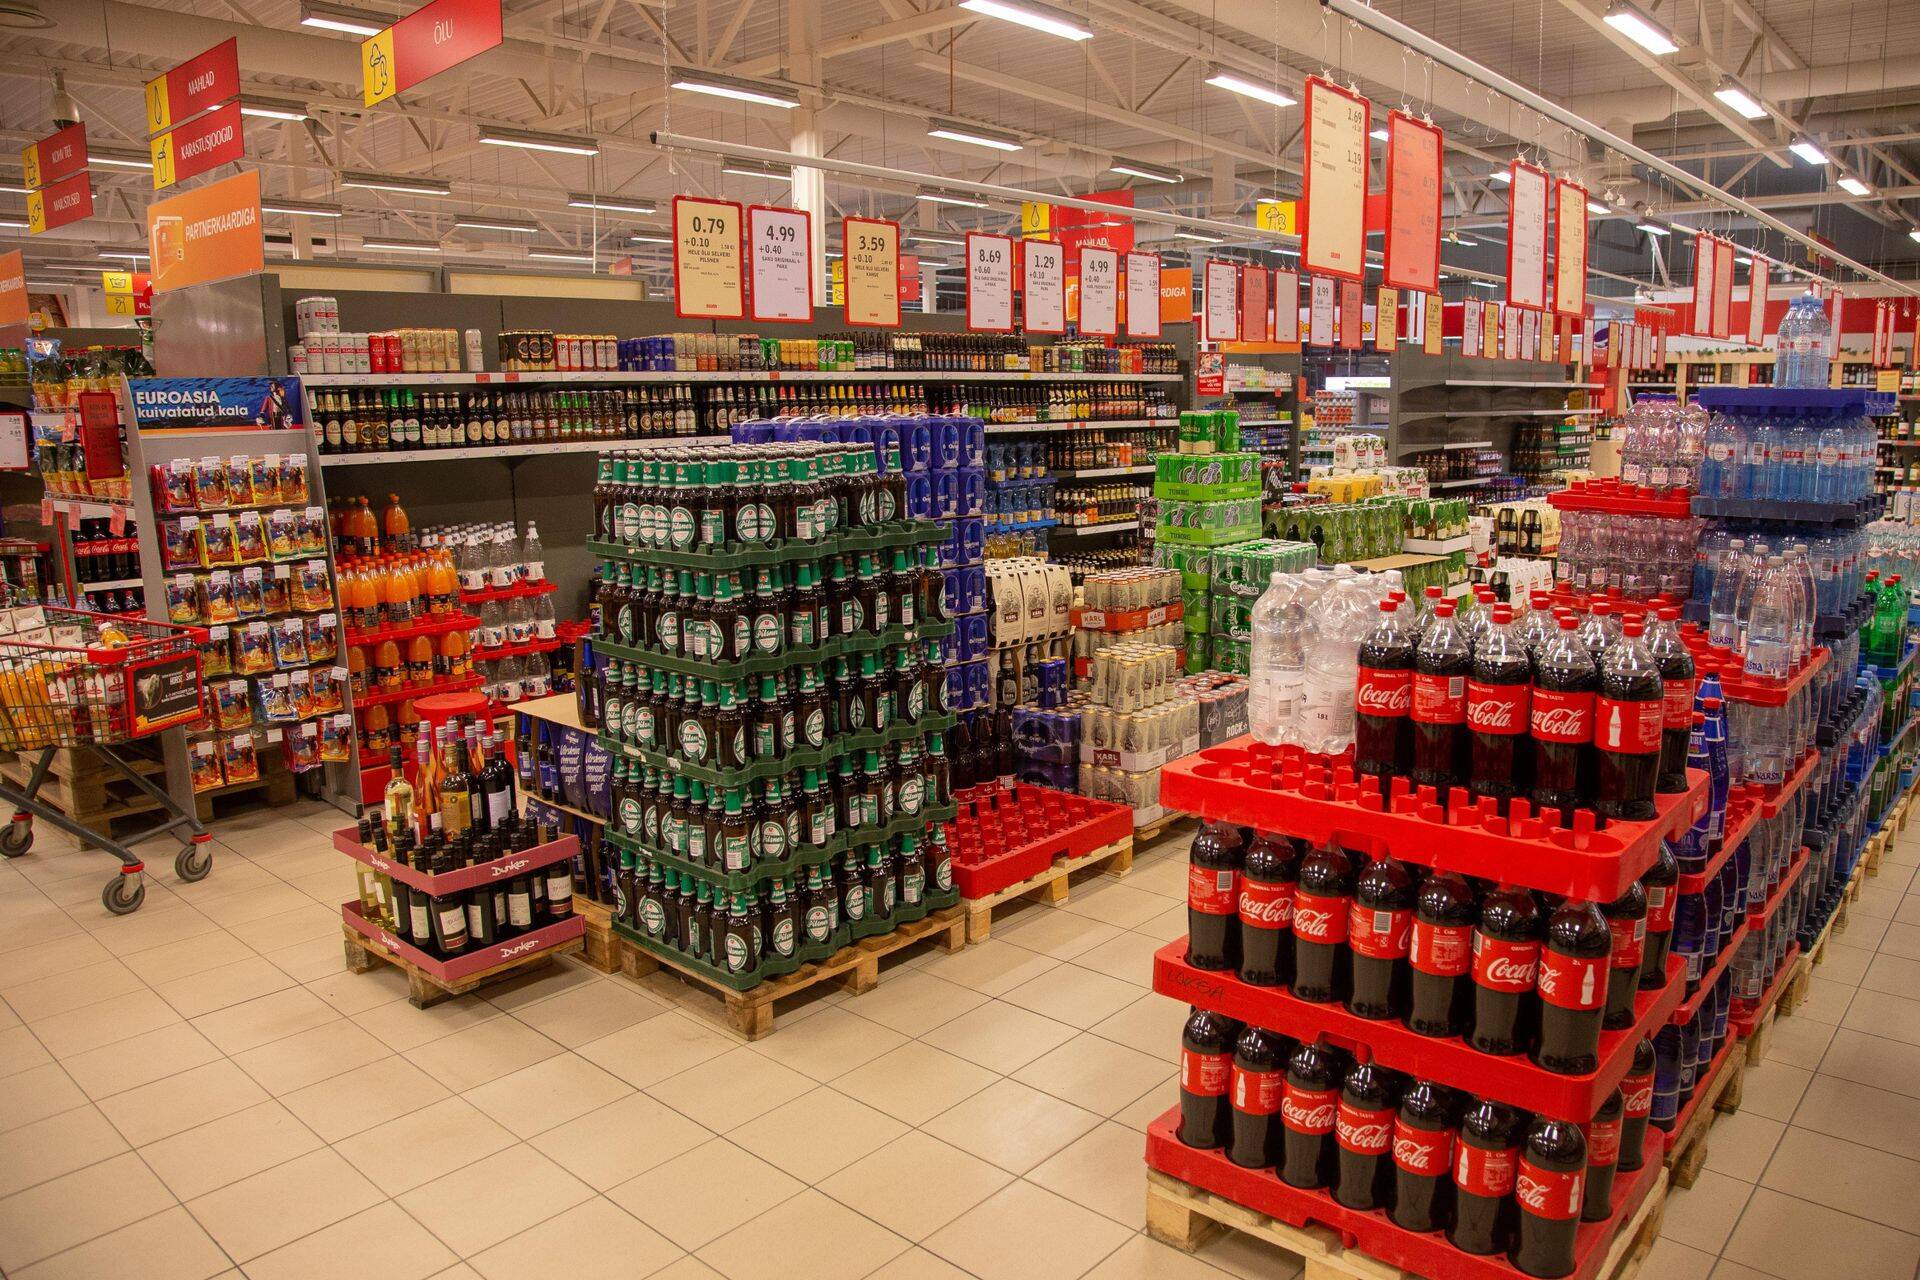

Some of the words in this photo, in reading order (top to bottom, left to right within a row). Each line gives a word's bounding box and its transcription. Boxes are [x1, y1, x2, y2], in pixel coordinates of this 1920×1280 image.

[433, 18, 455, 46] ÕLU
[188, 70, 215, 96] MAHLAD
[1346, 107, 1363, 123] 1.69
[181, 125, 234, 160] KARASTUSJOOGID
[1346, 149, 1362, 165] 1.19
[185, 206, 256, 242] PARTNERKAARDIGA
[692, 216, 725, 235] 0.79
[766, 225, 796, 243] 4.99
[684, 237, 710, 248] +0.10
[759, 244, 782, 255] +0.40
[859, 236, 885, 252] 3.59
[1076, 237, 1107, 248] MAHLAD
[852, 254, 873, 264] +0.10
[979, 249, 1001, 264] 8.69
[1034, 255, 1055, 270] 1.29
[1089, 260, 1109, 273] 4.99
[1316, 286, 1330, 297] 8.99
[1383, 297, 1394, 307] 7.29
[135, 390, 220, 405] EUROASIA
[136, 405, 214, 419] kuivatatud
[218, 404, 249, 417] kala
[1229, 580, 1260, 596] Carlsberg
[1096, 753, 1118, 762] KARL
[490, 857, 530, 878] Dunker
[500, 938, 540, 958] Dunker
